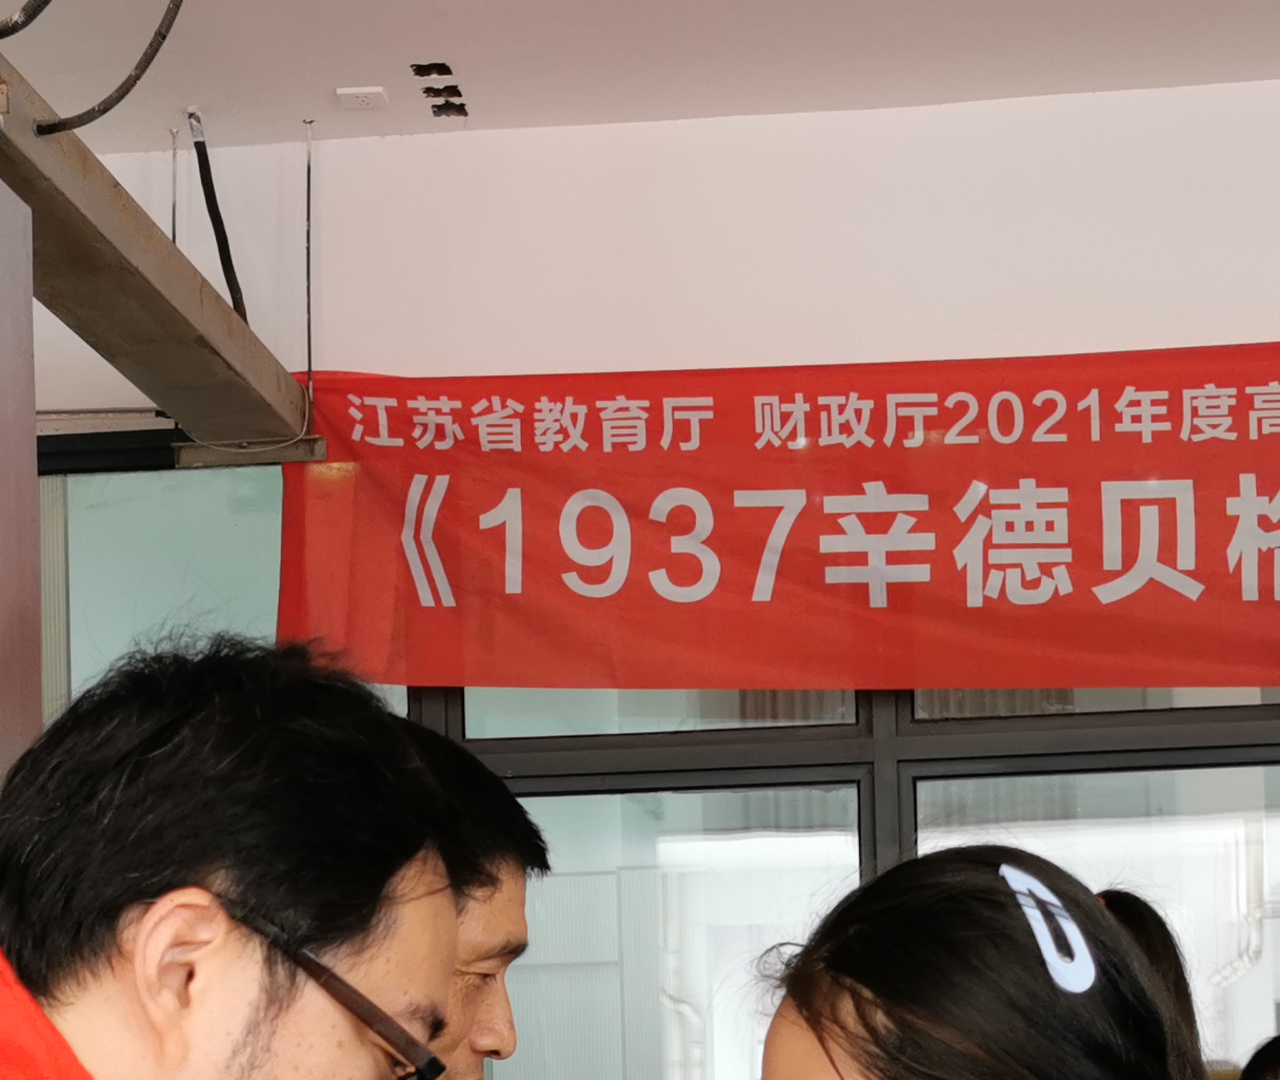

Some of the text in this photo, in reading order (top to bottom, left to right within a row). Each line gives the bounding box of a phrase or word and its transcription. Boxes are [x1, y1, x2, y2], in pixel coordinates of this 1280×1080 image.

[347, 393, 714, 453] 江苏省教育厅
